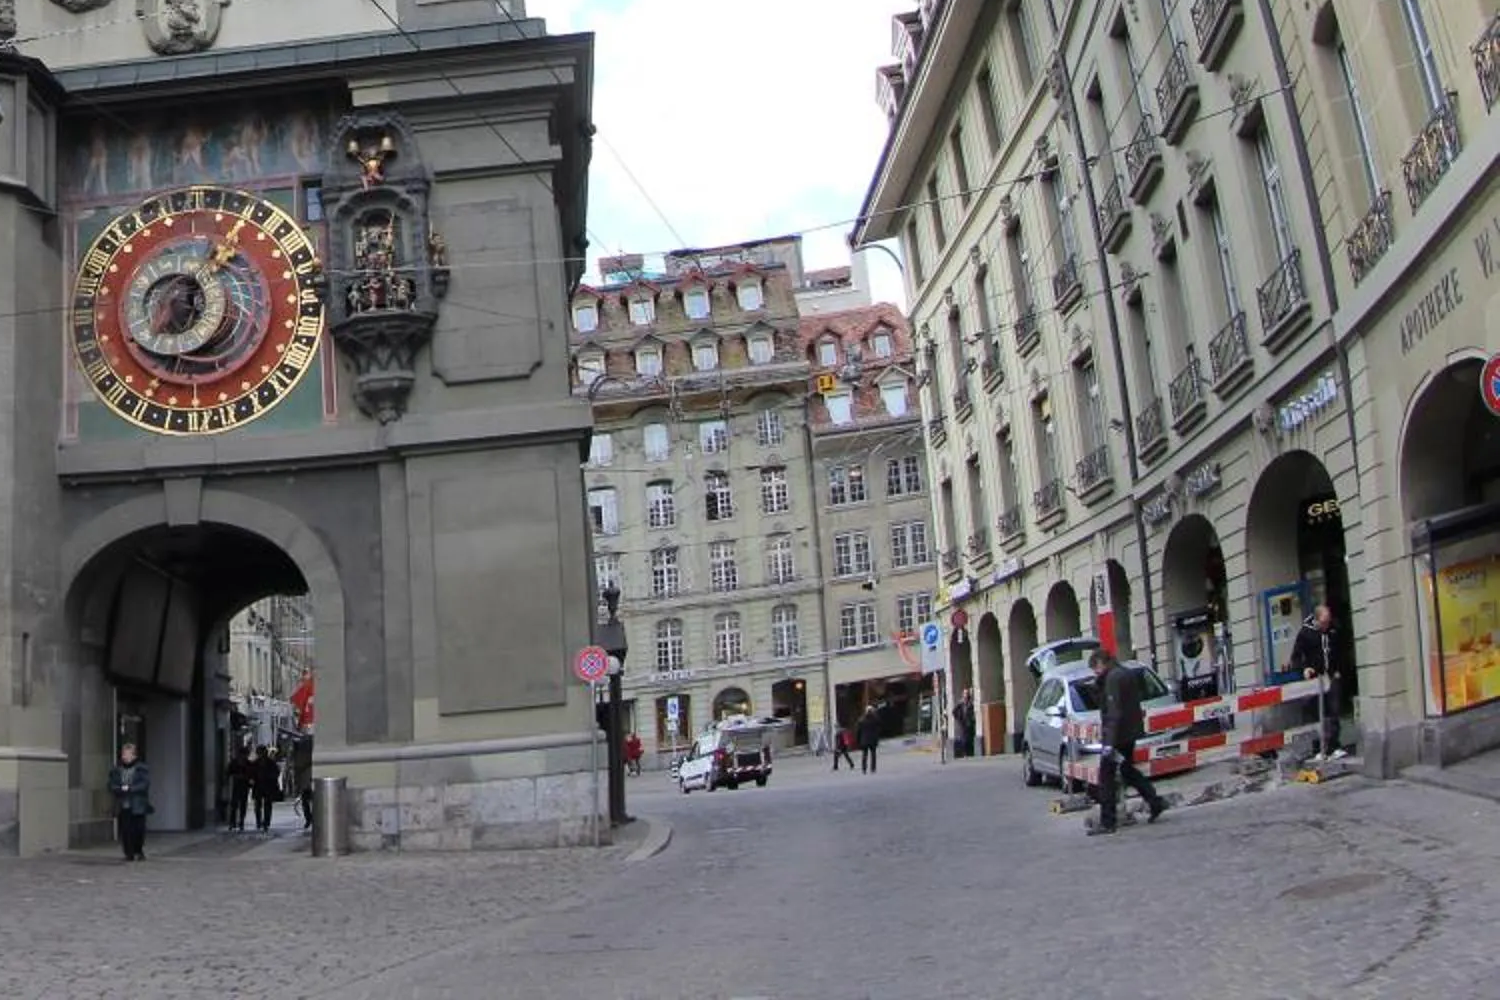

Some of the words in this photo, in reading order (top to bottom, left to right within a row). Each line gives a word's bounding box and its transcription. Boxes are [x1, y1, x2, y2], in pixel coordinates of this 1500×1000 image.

[263, 209, 285, 233] III
[280, 230, 306, 255] IIII
[1399, 266, 1464, 357] APOTHEKE
